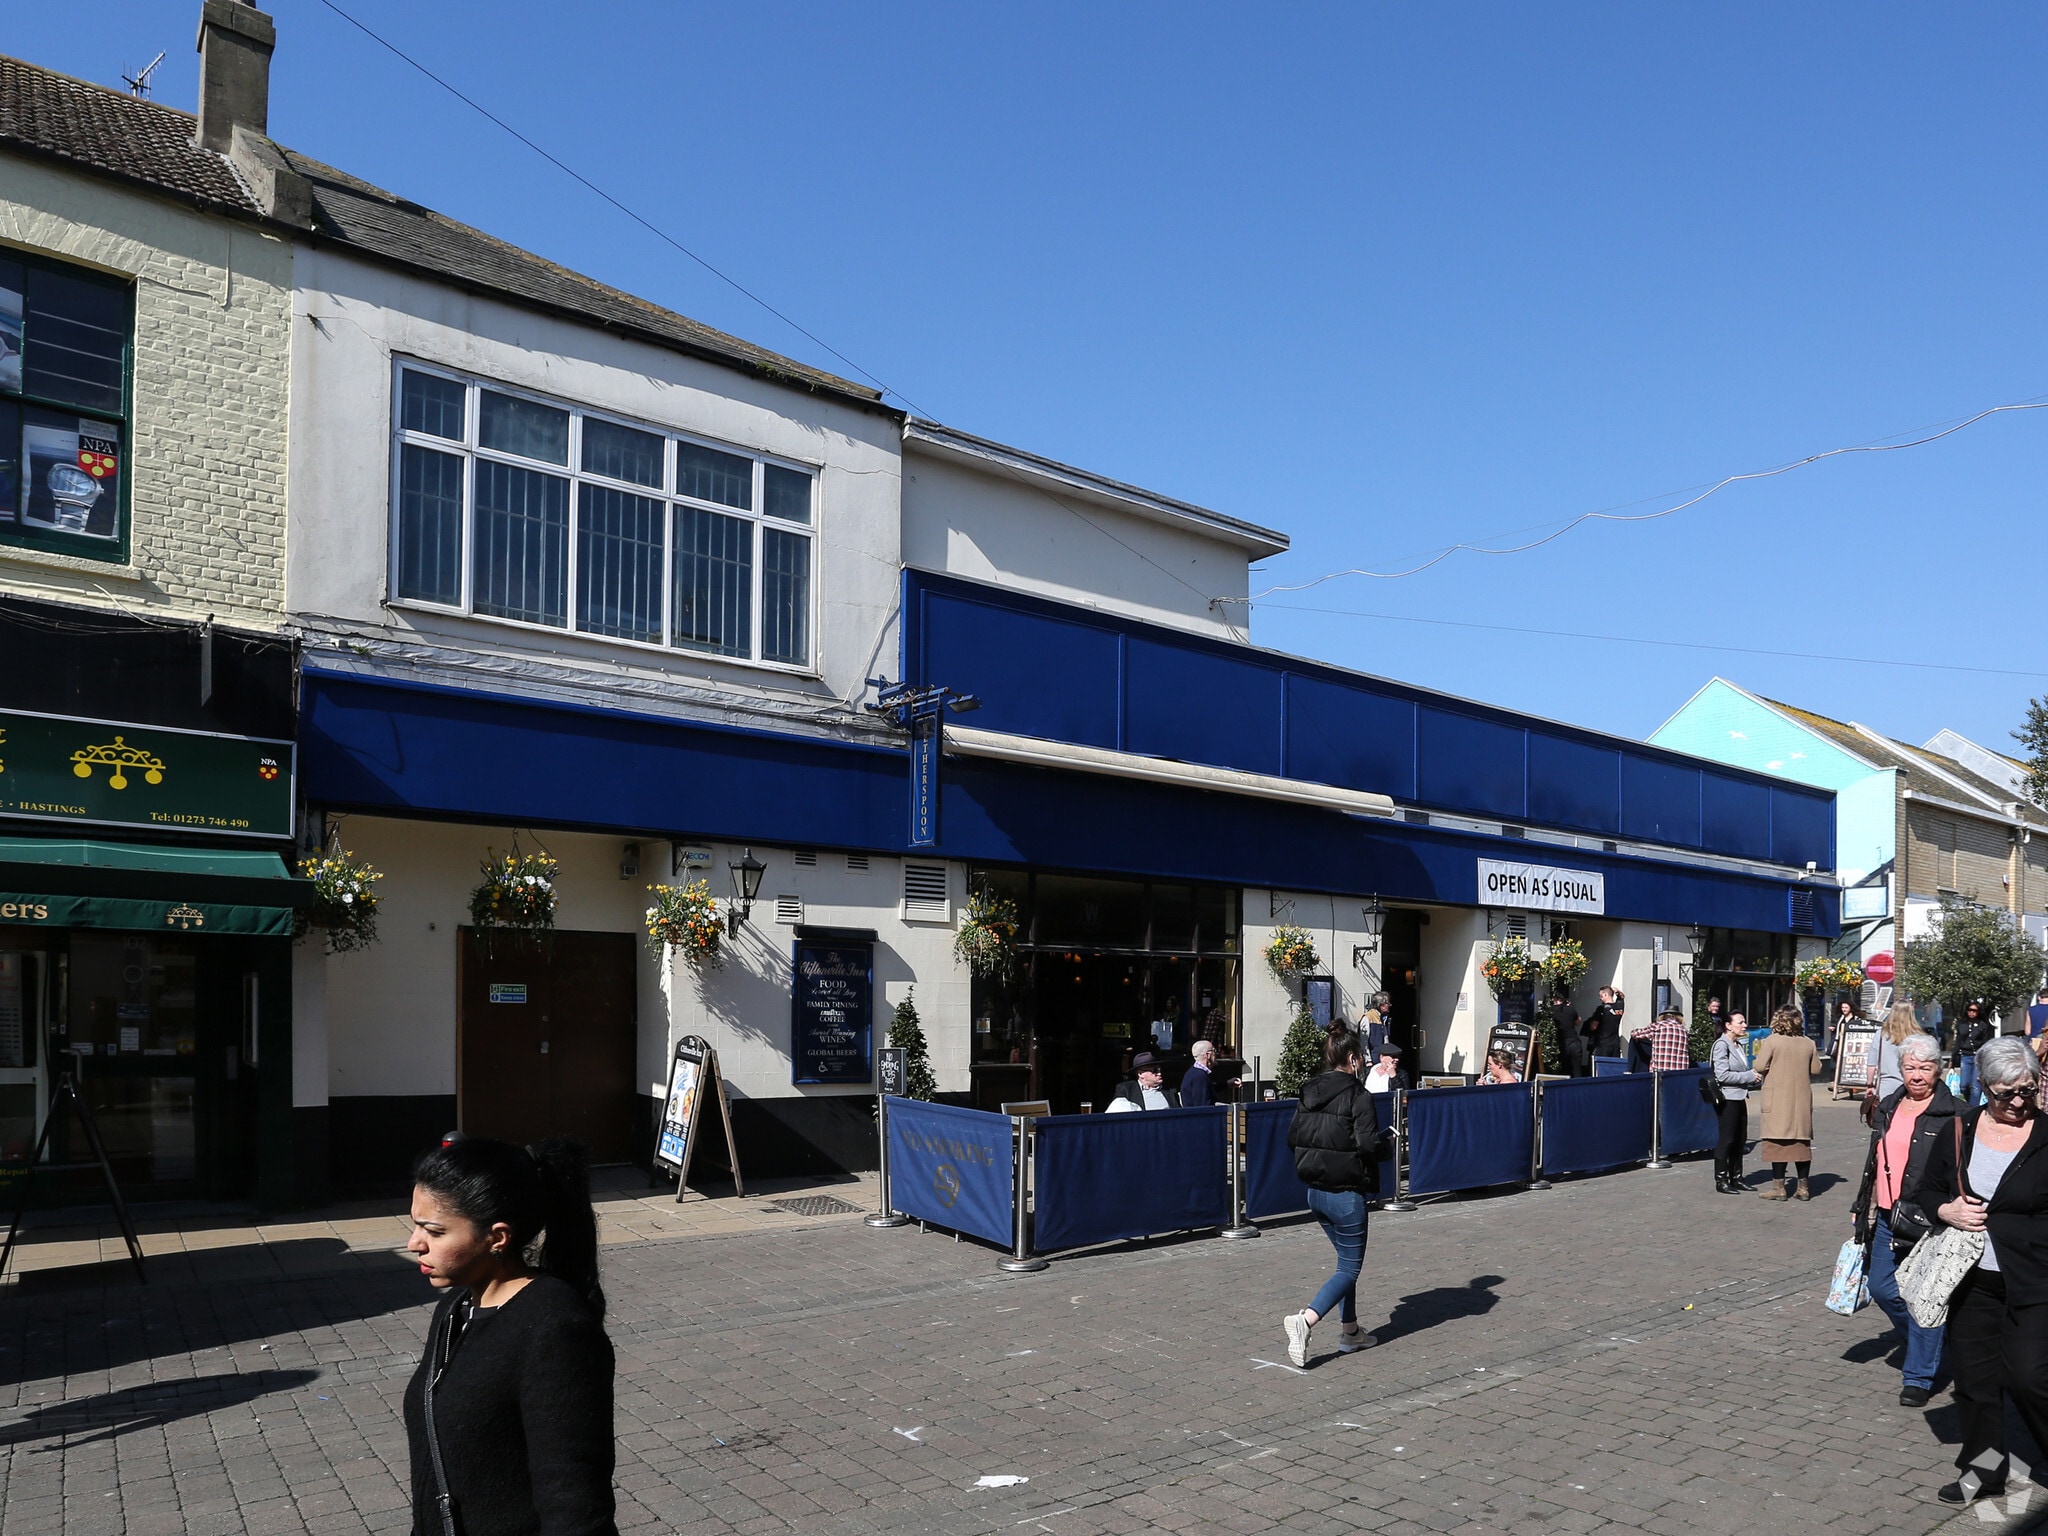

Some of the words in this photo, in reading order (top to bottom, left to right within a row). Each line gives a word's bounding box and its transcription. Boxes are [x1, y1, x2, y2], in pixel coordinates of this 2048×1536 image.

[83, 437, 113, 454] NPA
[260, 757, 277, 767] NPA
[20, 801, 86, 815] HASTINGS
[150, 812, 171, 822] Tel:
[173, 814, 205, 825] 01273
[208, 817, 227, 827] 746
[230, 819, 249, 829] 490
[685, 851, 710, 861] ECOM
[1488, 873, 1527, 895] OPEN
[1532, 878, 1549, 897] AS
[1554, 880, 1597, 902] USUAL
[0, 902, 48, 919] ers
[120, 935, 147, 951] 102
[826, 952, 841, 963] The
[800, 961, 846, 980] Cliftonville
[847, 962, 867, 977] Inn
[819, 979, 847, 989] FOOD
[832, 1001, 859, 1009] DINING
[819, 1035, 847, 1043] WINES
[925, 1135, 994, 1167] SMOKING
